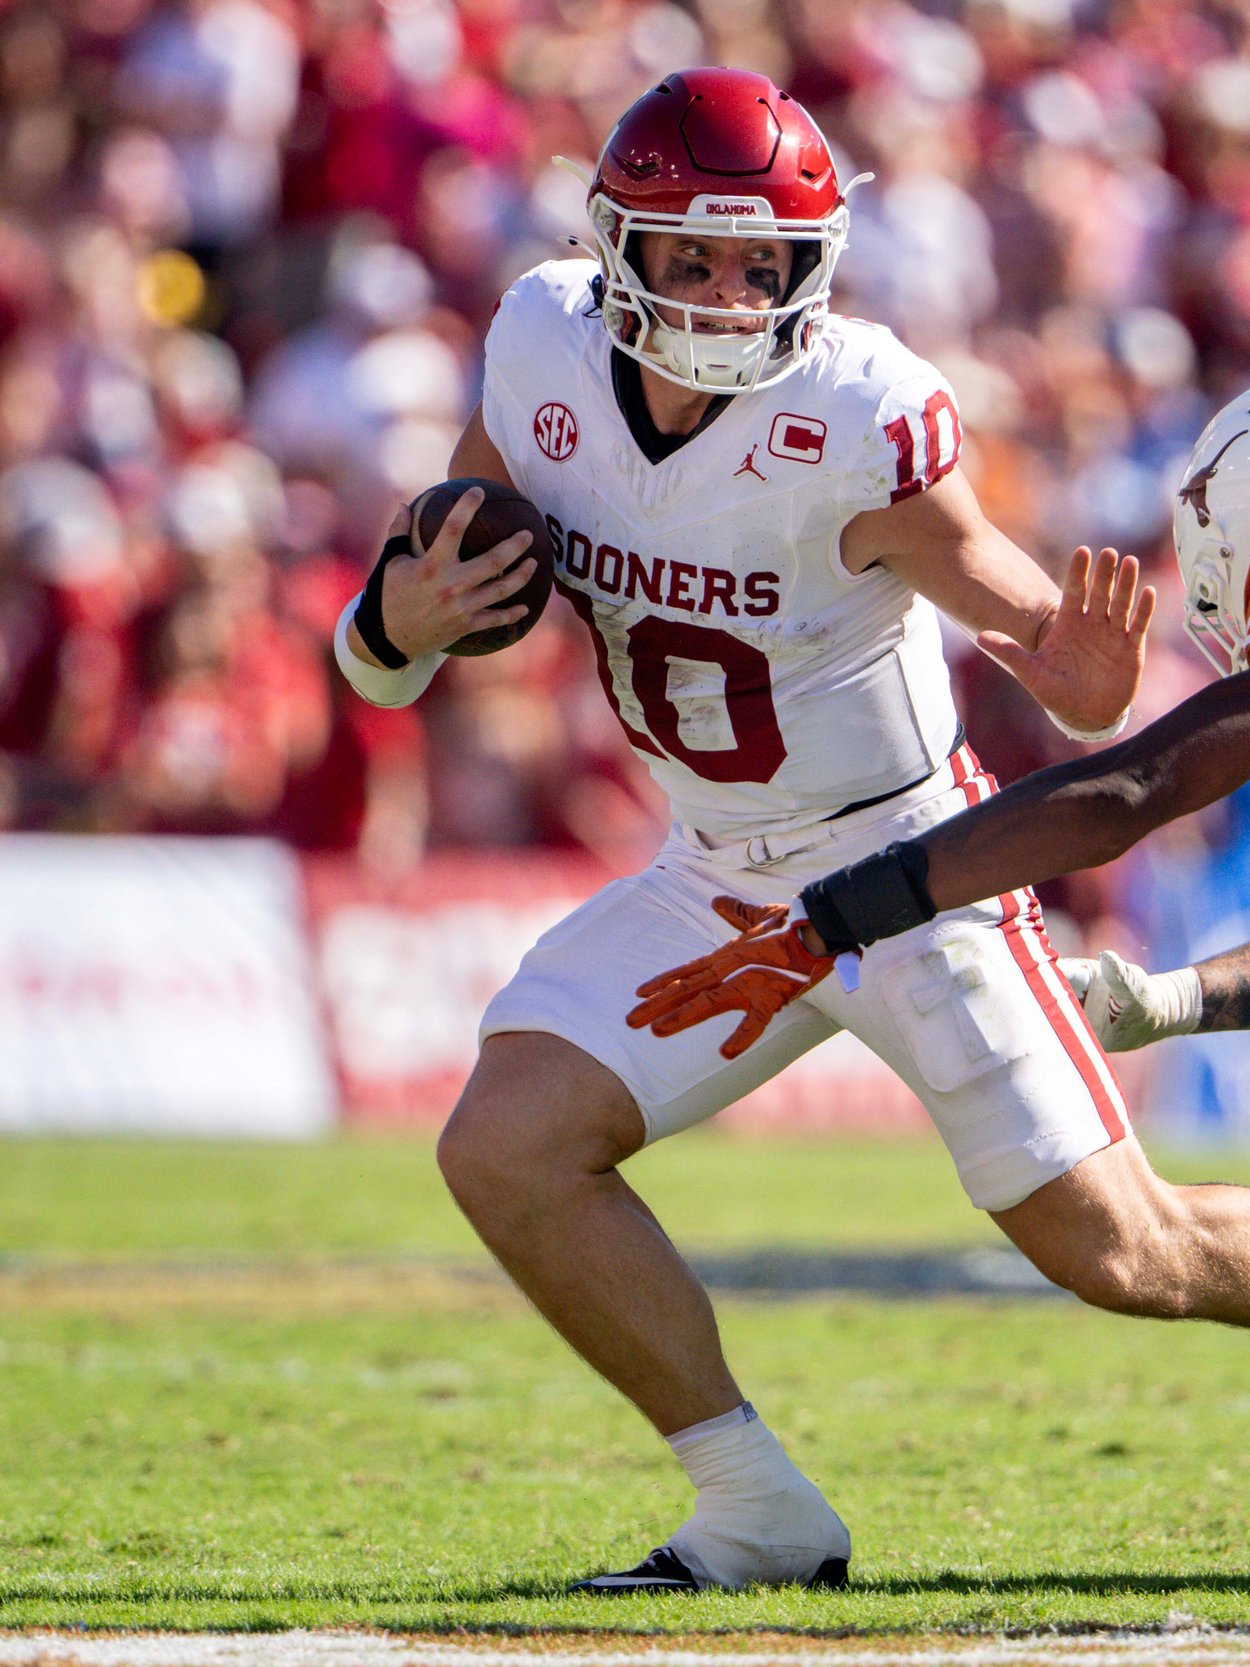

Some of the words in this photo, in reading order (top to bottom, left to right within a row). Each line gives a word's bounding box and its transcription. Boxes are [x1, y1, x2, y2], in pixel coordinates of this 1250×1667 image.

[706, 203, 757, 216] OKLAHOMA
[534, 402, 578, 461] SEC
[768, 412, 827, 464] C
[883, 389, 962, 506] 10
[545, 513, 781, 617] SOONERS
[553, 575, 789, 785] 10
